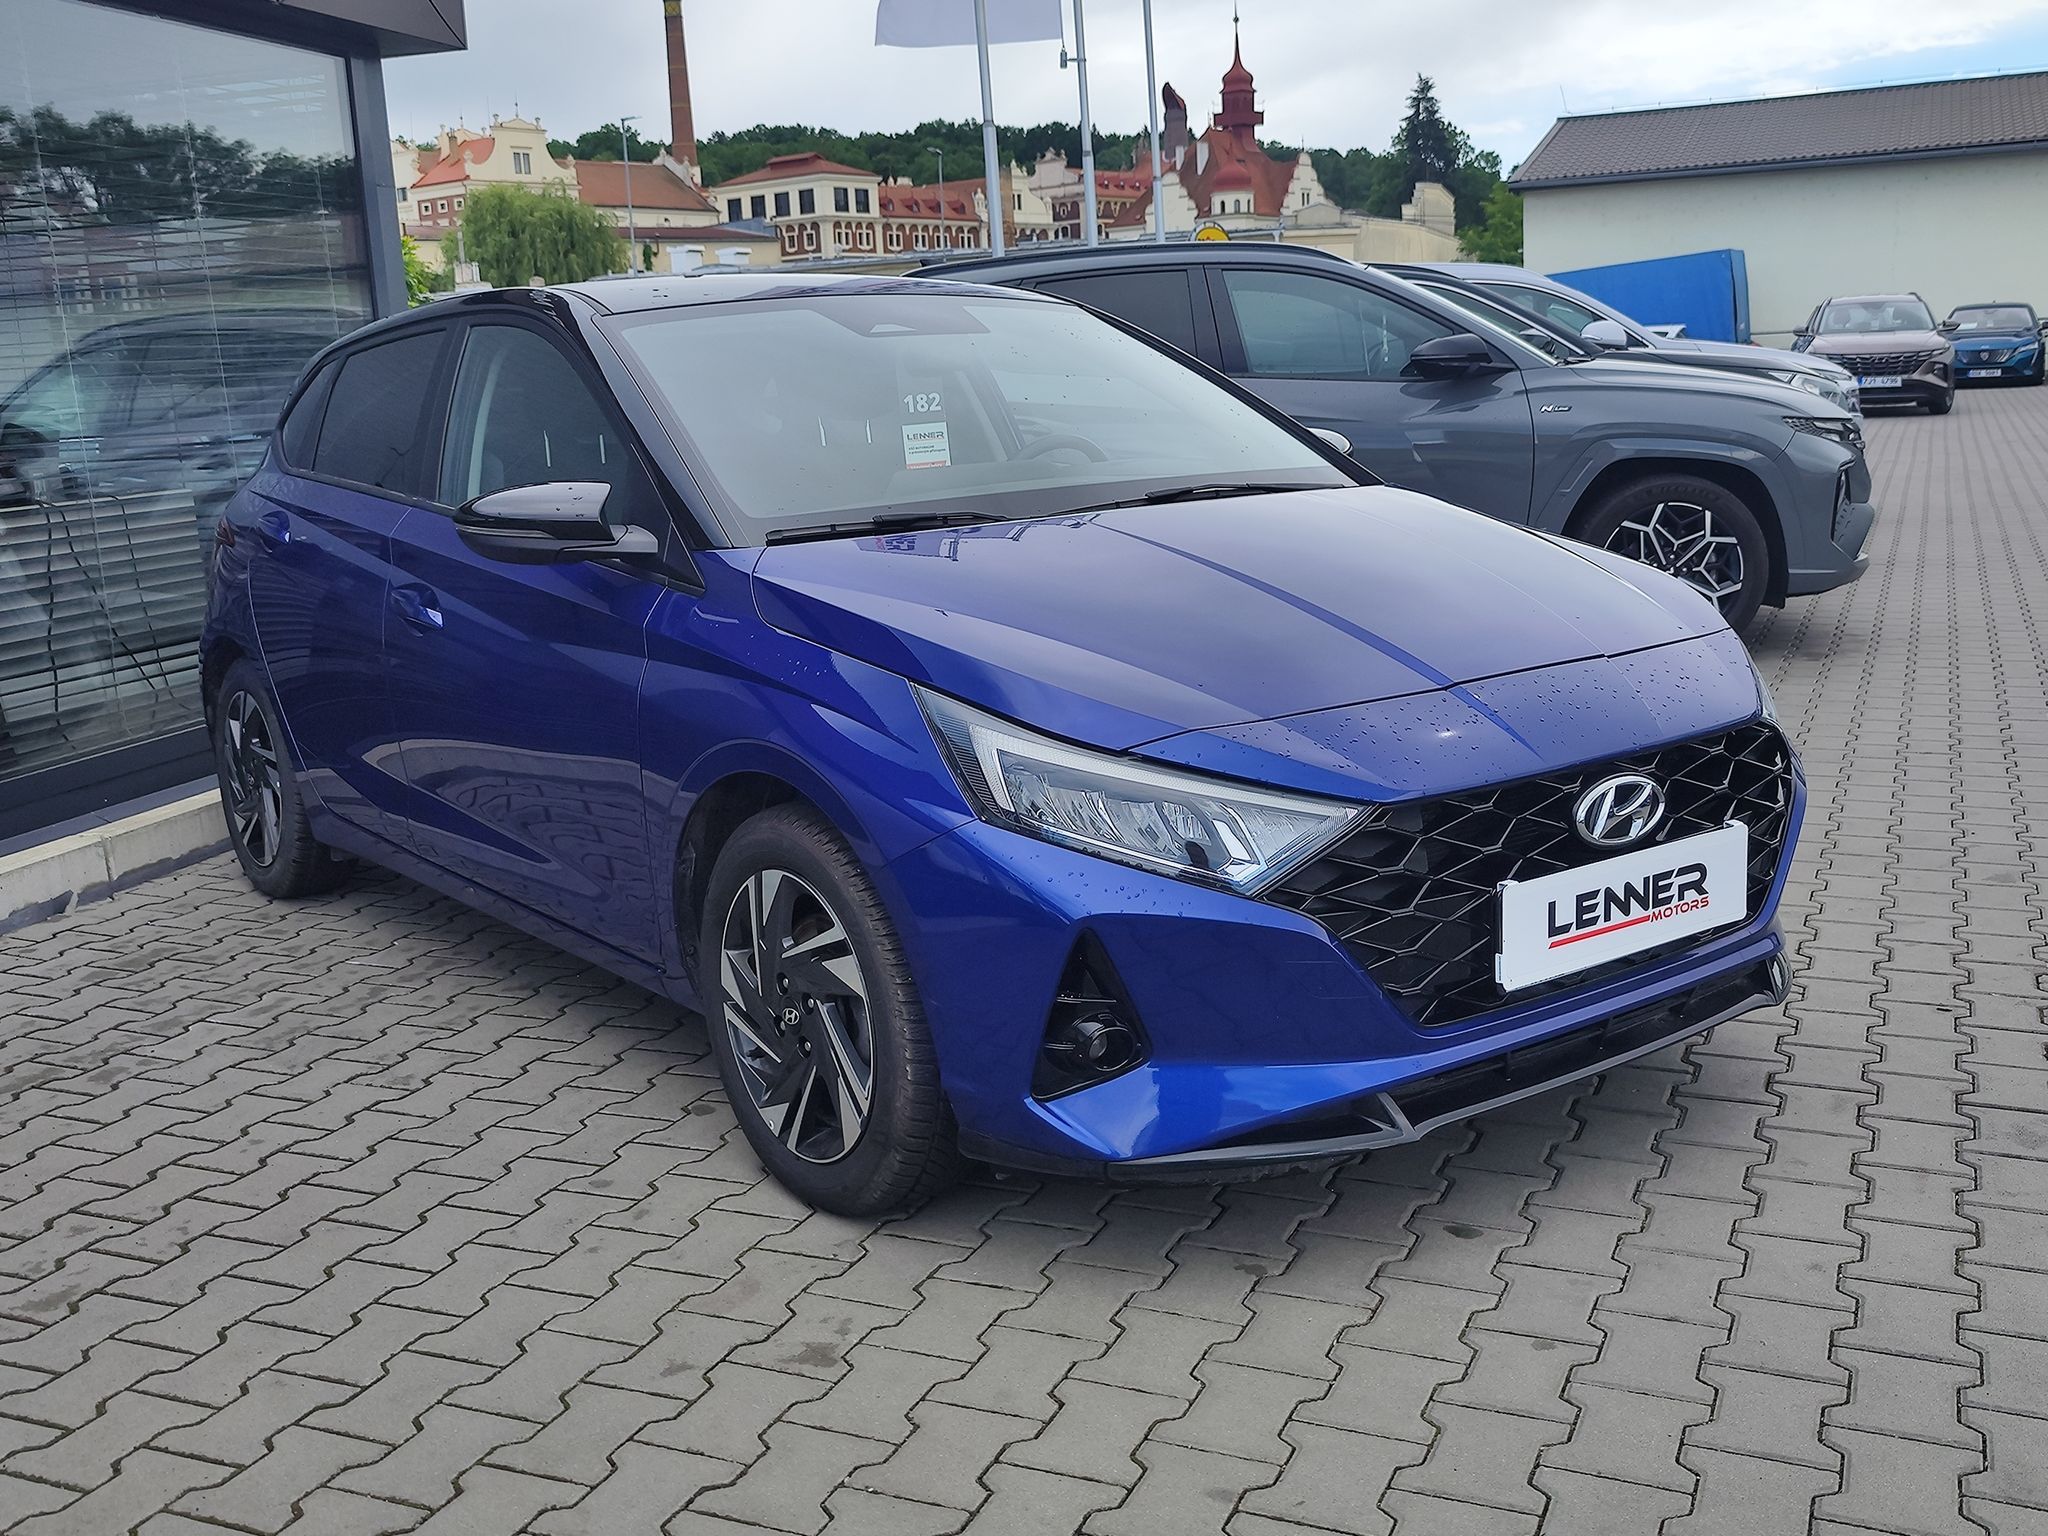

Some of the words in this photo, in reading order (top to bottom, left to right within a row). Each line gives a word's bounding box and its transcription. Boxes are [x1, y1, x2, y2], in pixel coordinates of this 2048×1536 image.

[903, 392, 942, 413] 182
[906, 431, 945, 441] LENNER
[1548, 862, 1709, 939] LENNER
[1650, 896, 1710, 923] MOTORS
